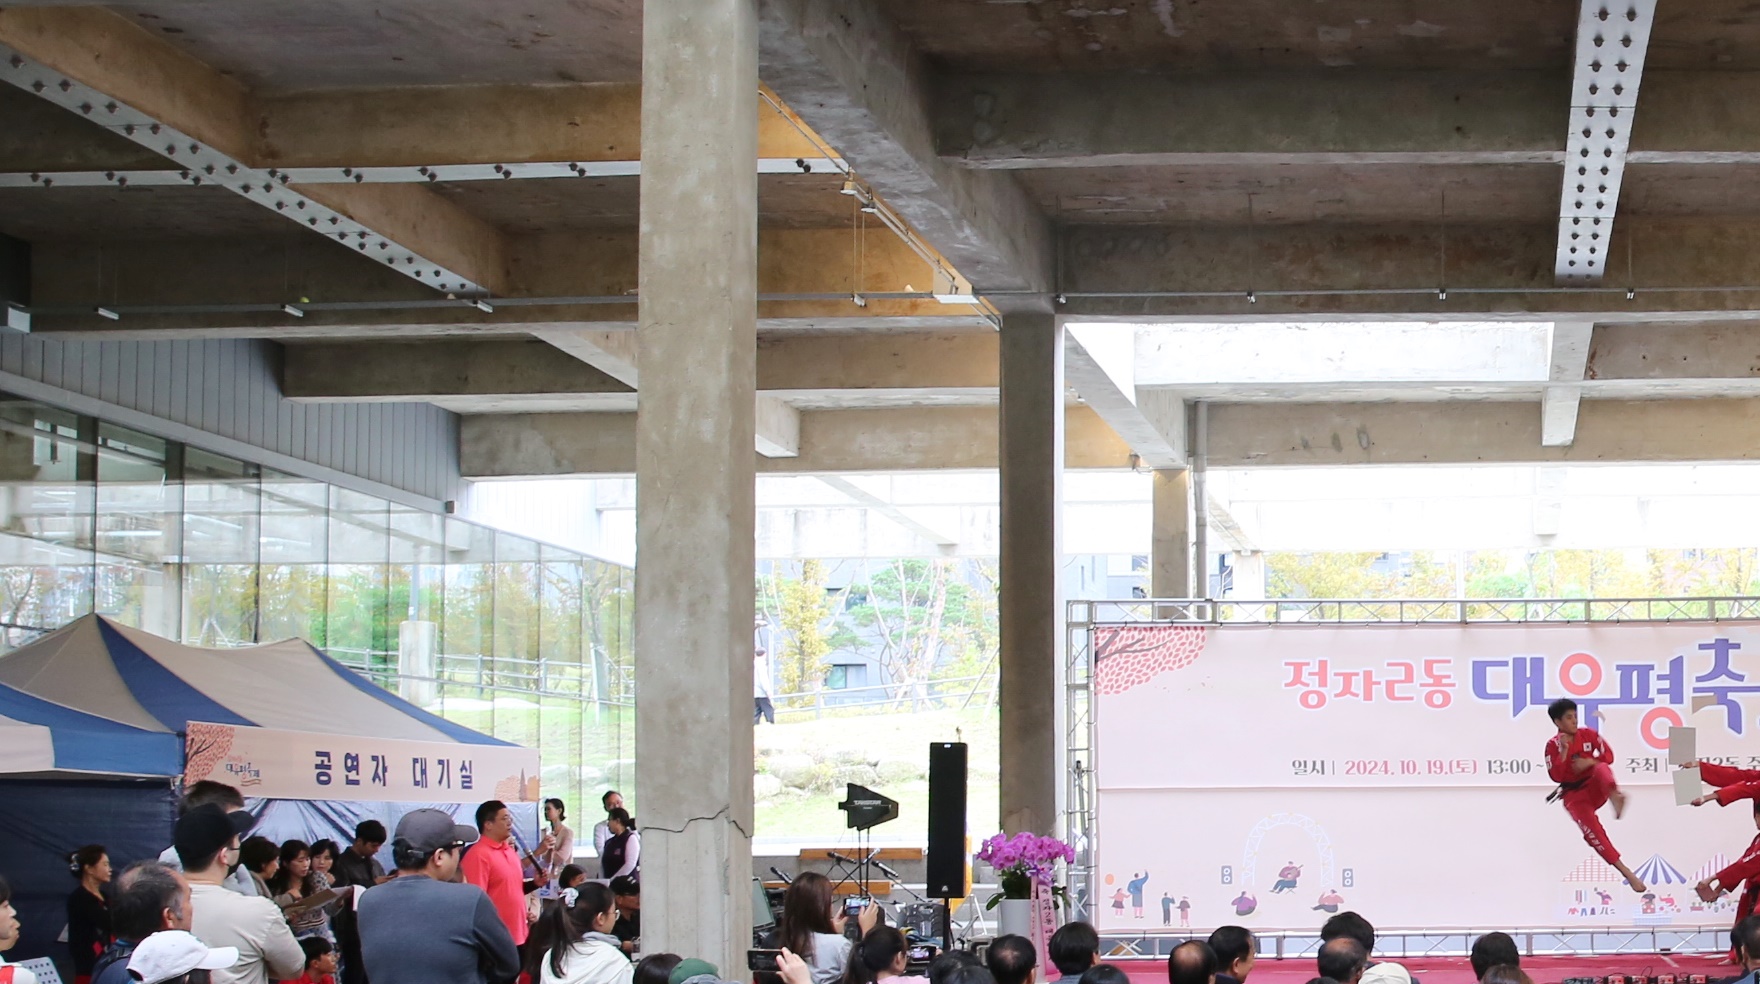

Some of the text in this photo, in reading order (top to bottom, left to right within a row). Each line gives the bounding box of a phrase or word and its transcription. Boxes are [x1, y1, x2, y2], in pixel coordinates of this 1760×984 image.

[1283, 659, 1457, 709] 정자2동
[315, 750, 473, 789] 공연자 대기실
[1292, 759, 1325, 776] 일시
[1344, 758, 1395, 776] 2024.
[1399, 758, 1422, 776] 10.
[1486, 758, 1532, 775] 13:00
[1625, 757, 1658, 773] 주최
